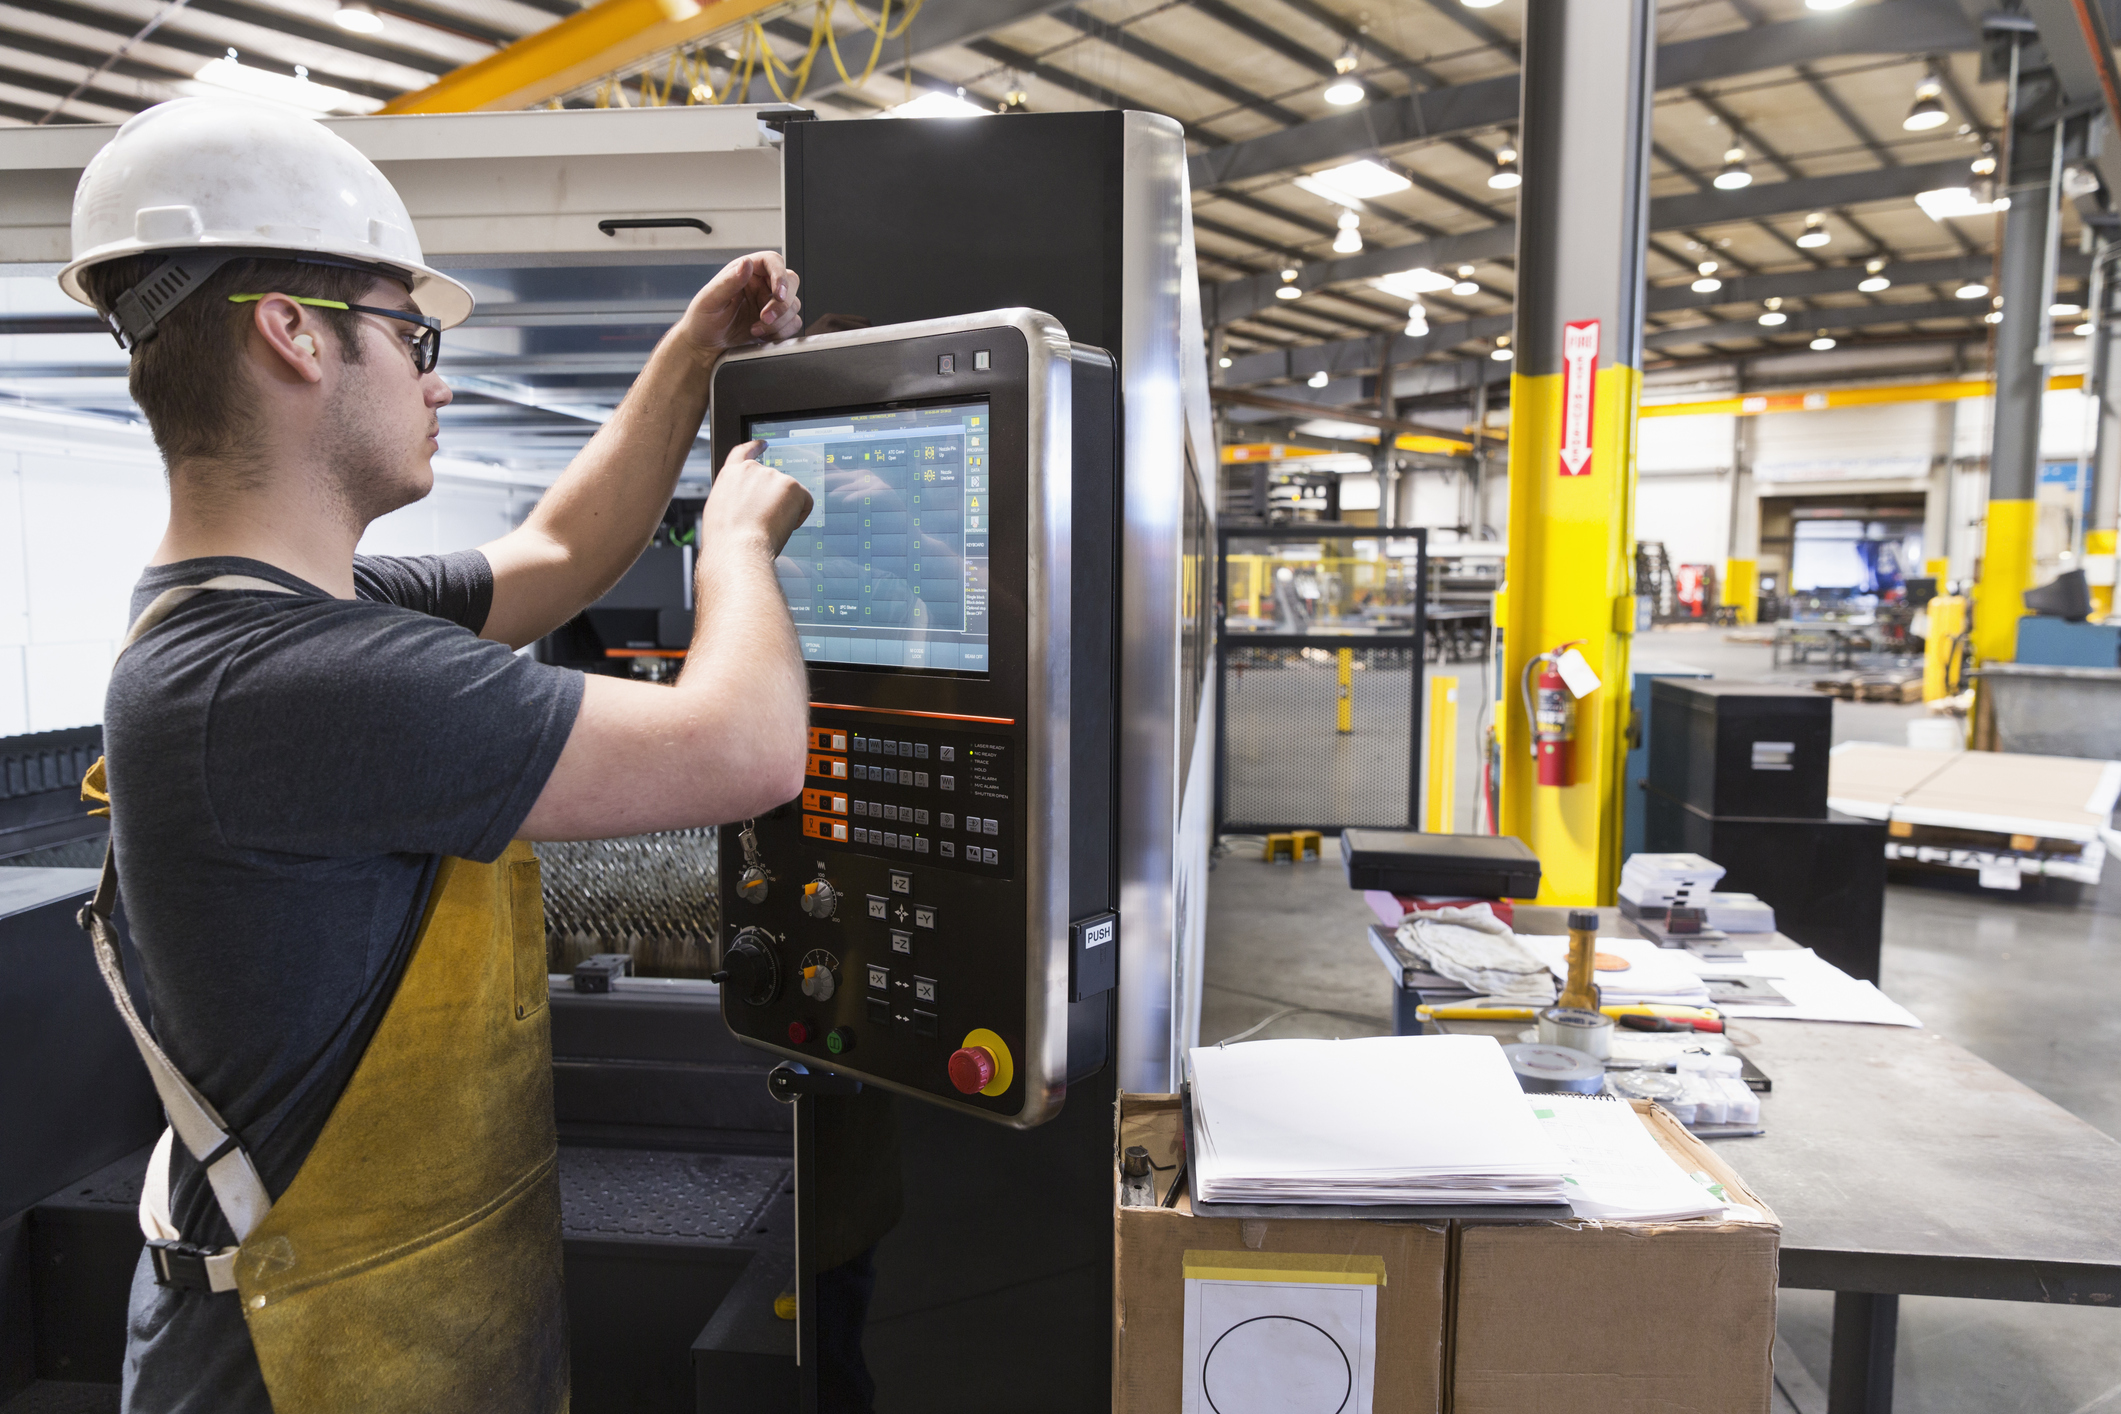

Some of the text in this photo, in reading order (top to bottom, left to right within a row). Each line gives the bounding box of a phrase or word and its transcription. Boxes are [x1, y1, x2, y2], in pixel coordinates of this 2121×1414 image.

[894, 880, 906, 890] +Z
[871, 904, 883, 914] +Y
[918, 914, 931, 924] -Y
[1088, 926, 1110, 943] PUSH
[895, 939, 908, 949] -Z
[871, 974, 883, 984] +X
[918, 986, 931, 997] -X
